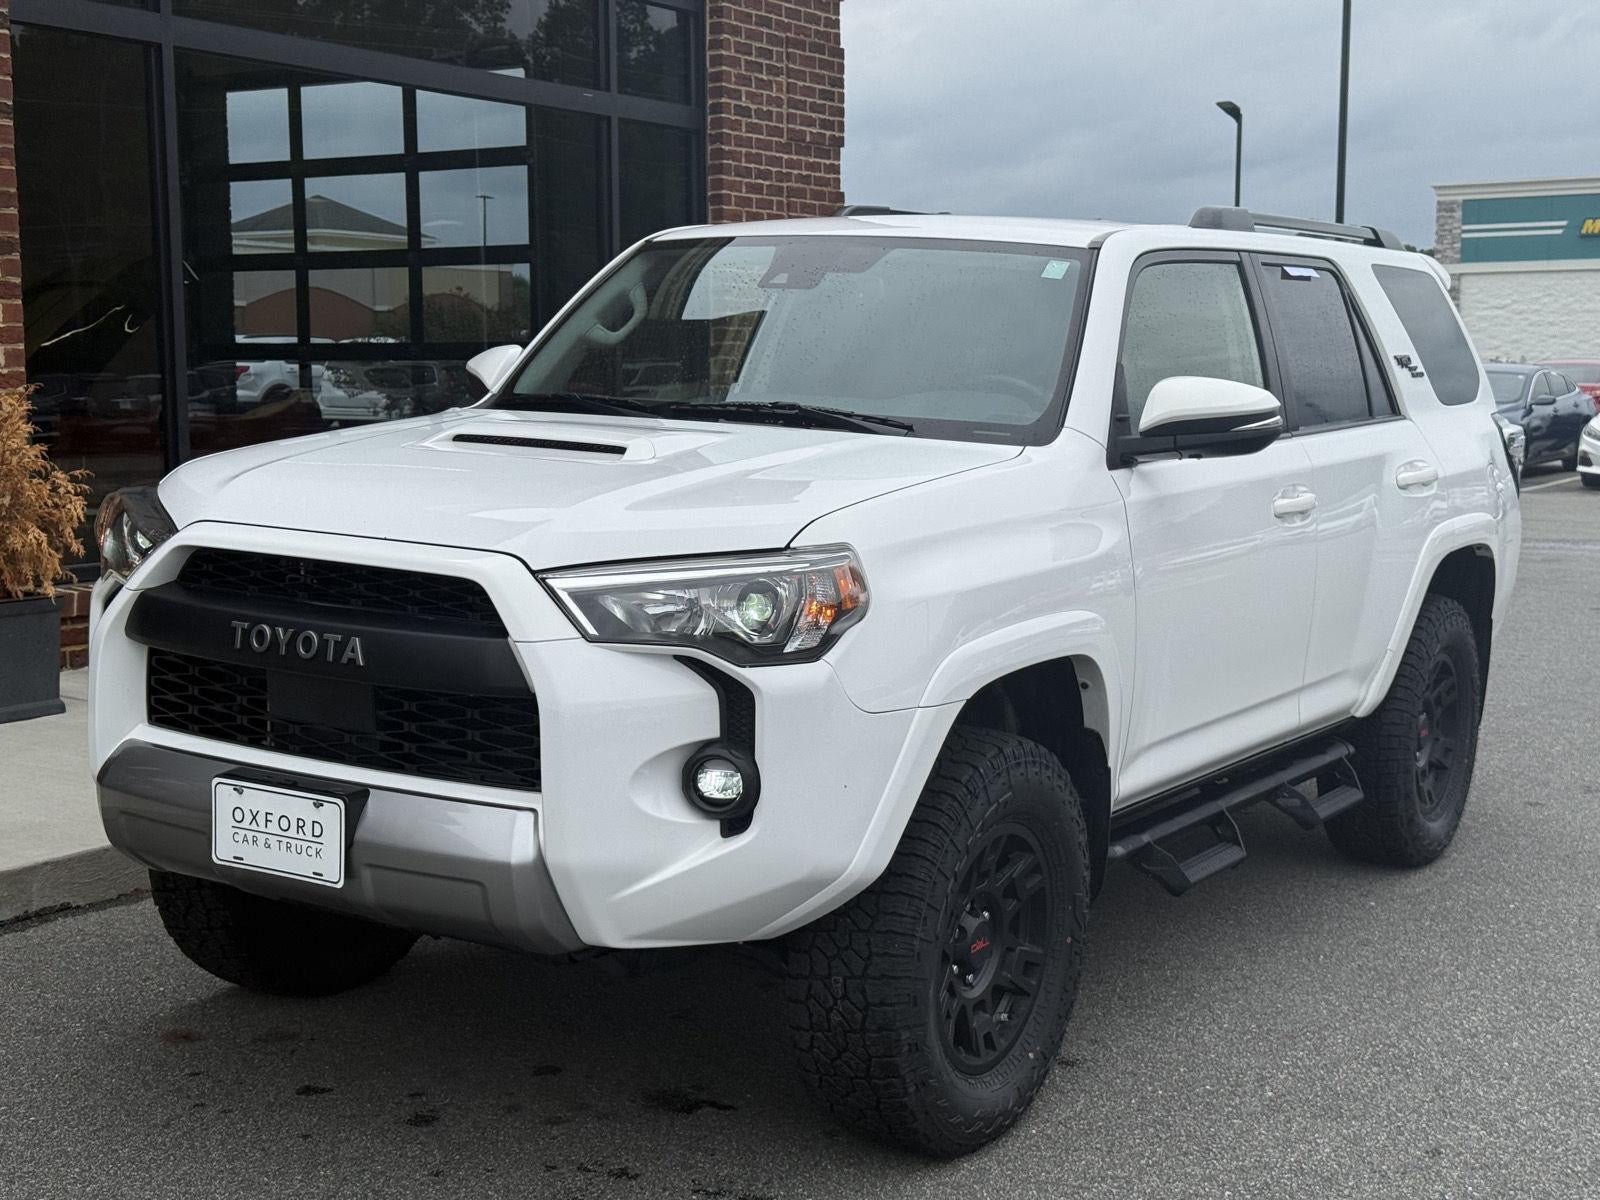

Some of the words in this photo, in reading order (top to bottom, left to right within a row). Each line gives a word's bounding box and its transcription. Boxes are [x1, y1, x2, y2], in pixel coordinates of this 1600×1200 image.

[230, 620, 365, 667] TOYOTA
[232, 806, 324, 838] OXFORD
[232, 831, 259, 847] CAR
[263, 837, 272, 850] &
[276, 839, 323, 860] TRUCK
